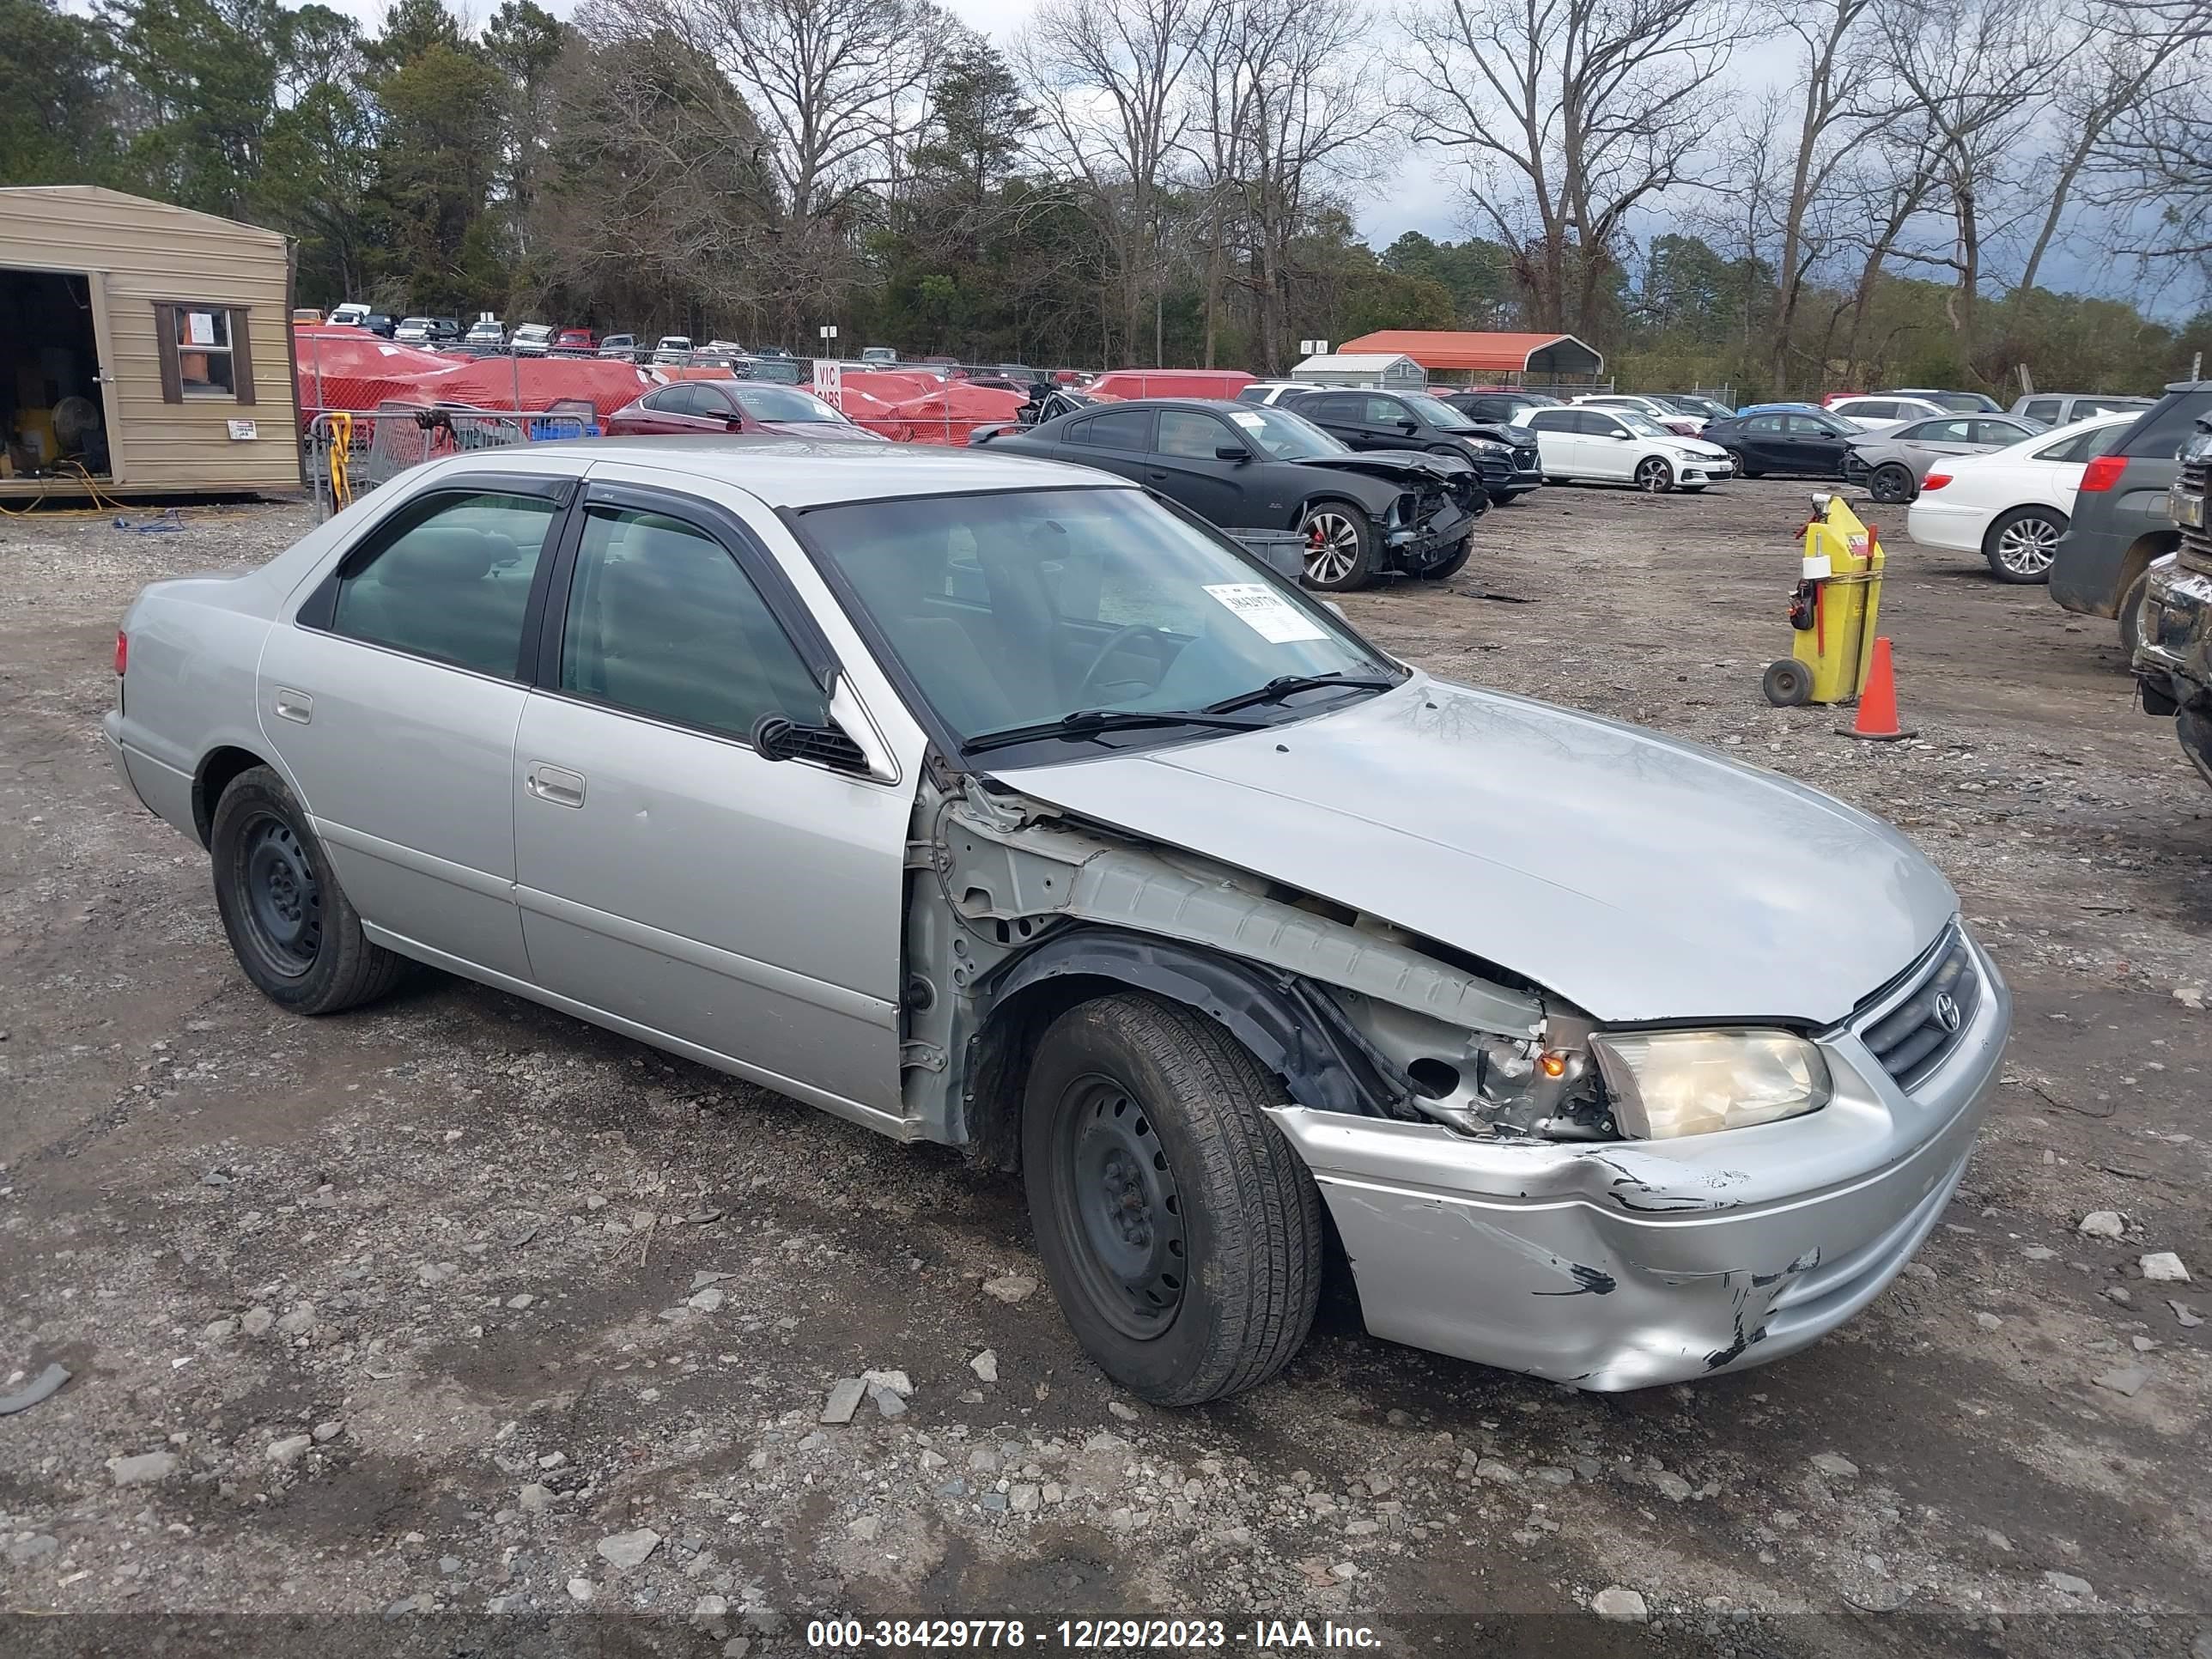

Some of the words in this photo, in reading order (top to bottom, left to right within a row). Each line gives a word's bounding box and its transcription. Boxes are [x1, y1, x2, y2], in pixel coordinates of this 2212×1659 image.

[1303, 342, 1310, 353] B
[1317, 342, 1326, 353] A
[819, 366, 836, 386] VIC
